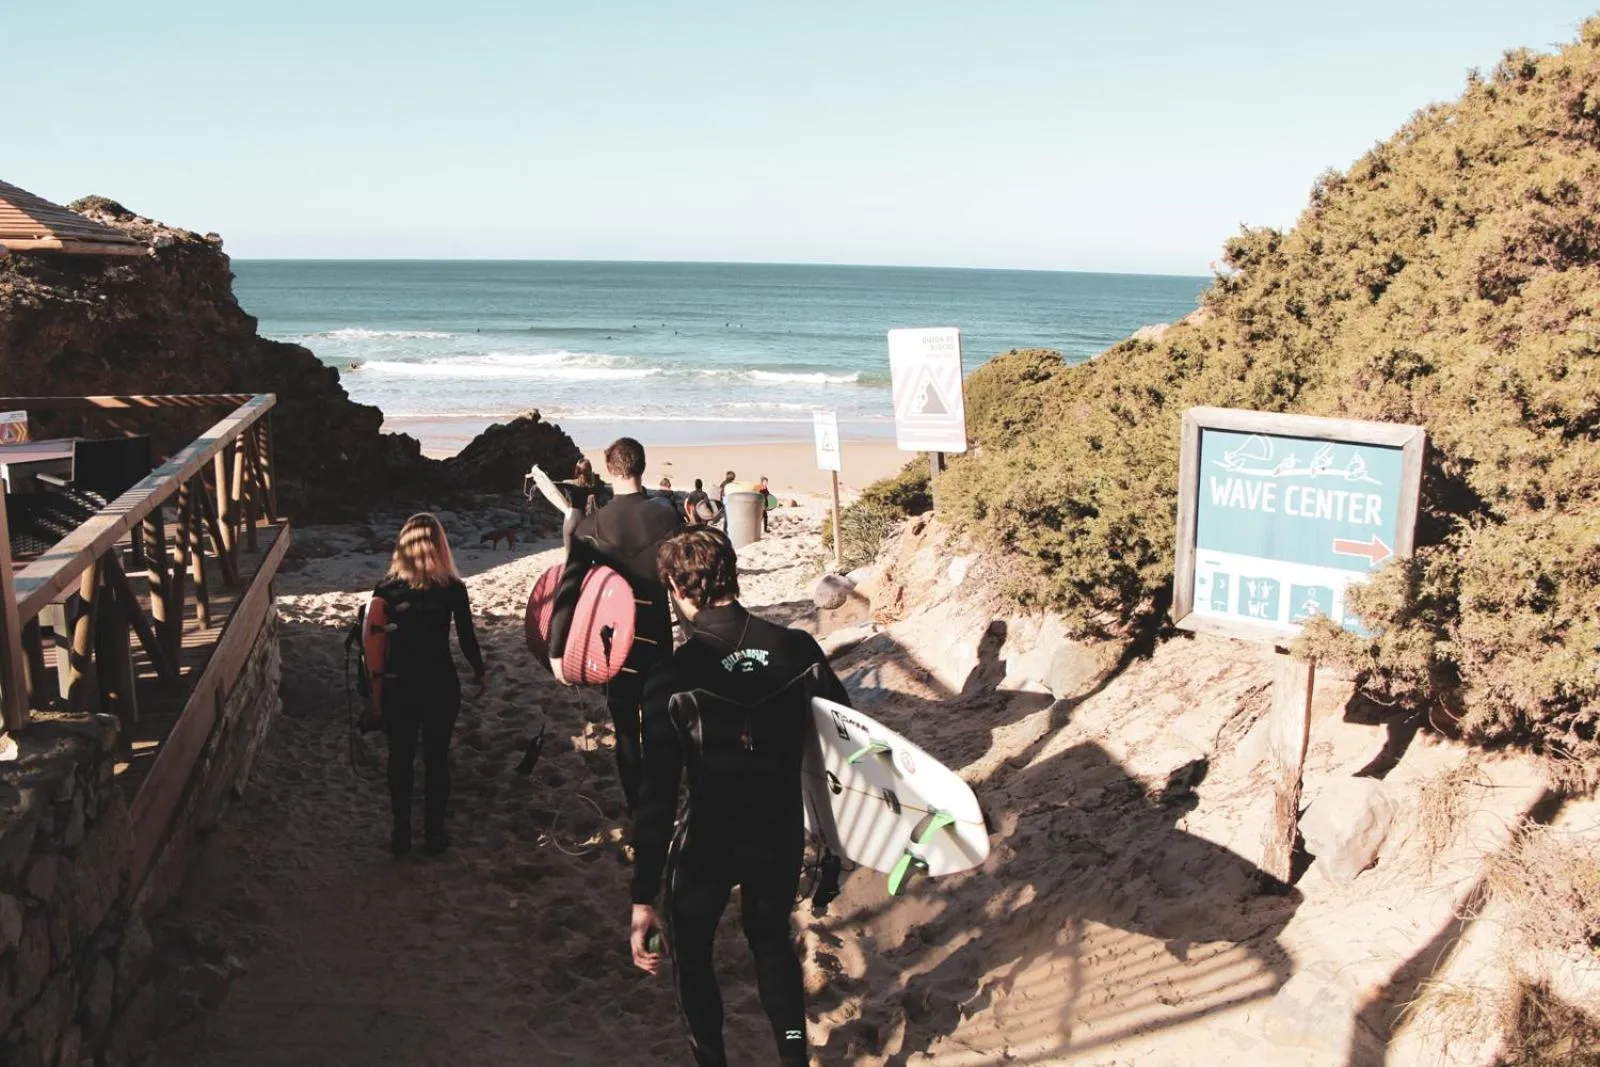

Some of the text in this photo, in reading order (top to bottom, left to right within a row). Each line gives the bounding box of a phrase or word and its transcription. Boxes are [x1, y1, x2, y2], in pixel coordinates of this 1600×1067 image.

[1210, 475, 1383, 526] WAVE CENTER
[1248, 599, 1269, 618] WC
